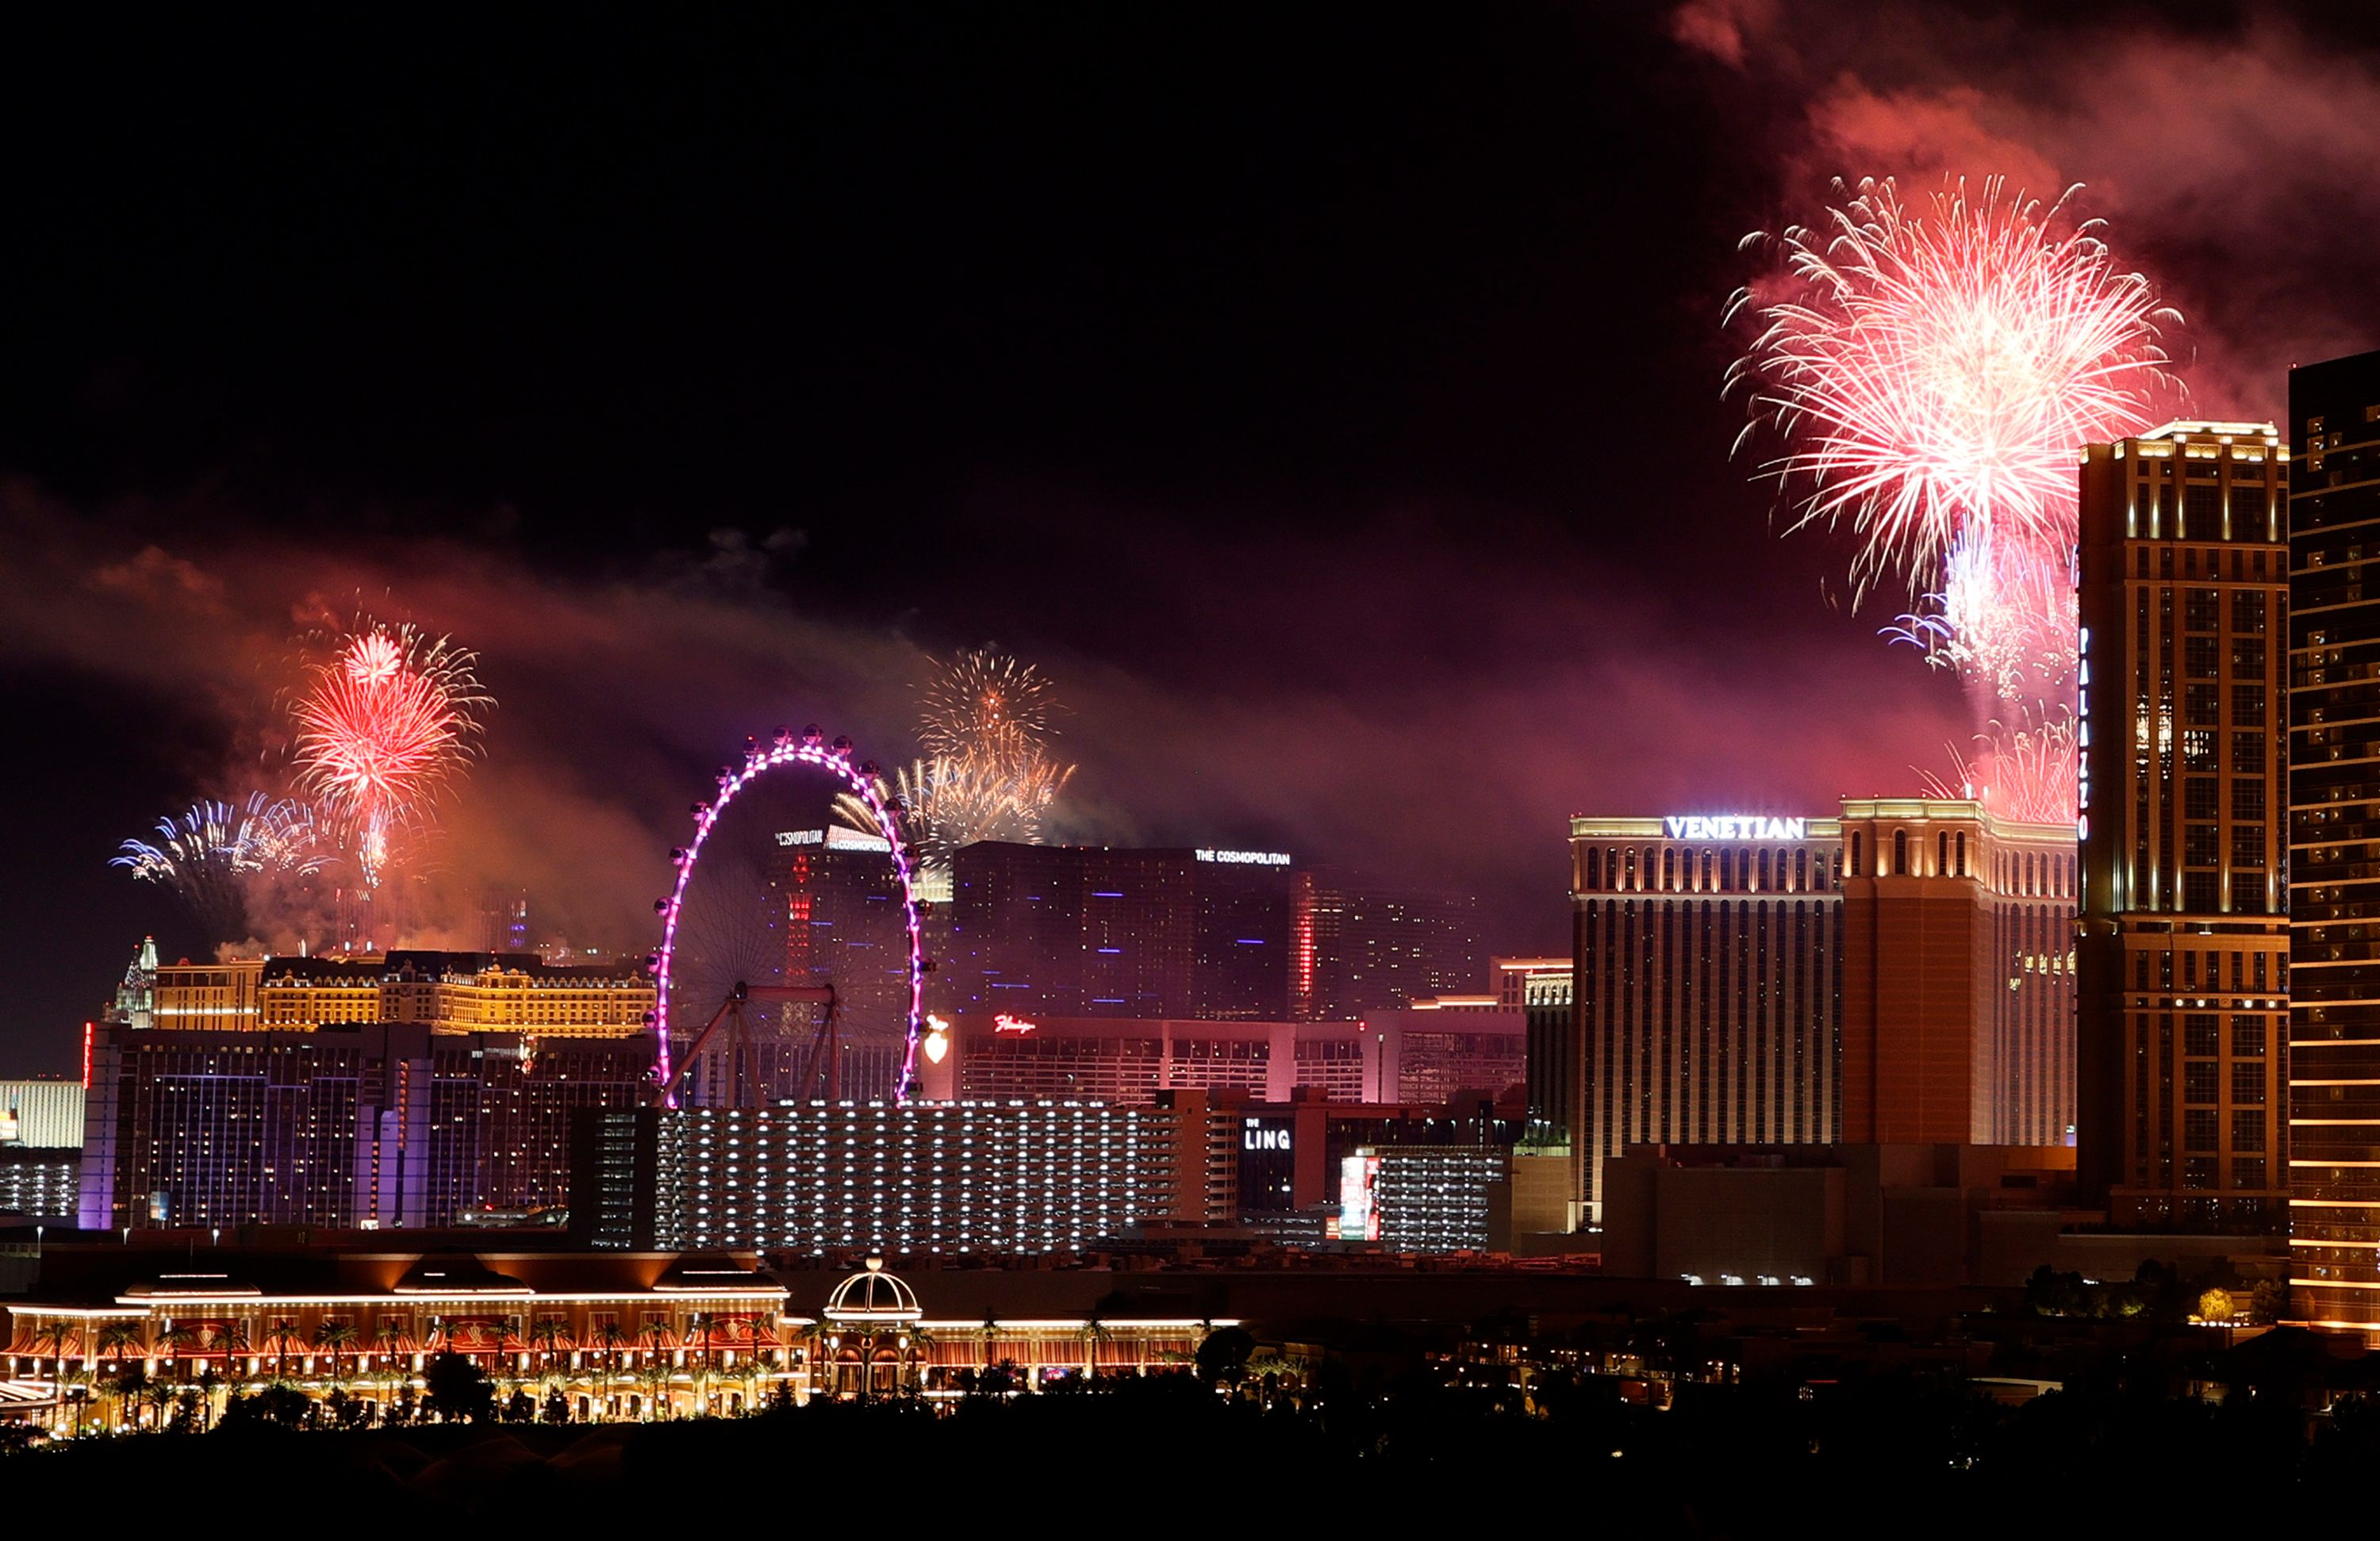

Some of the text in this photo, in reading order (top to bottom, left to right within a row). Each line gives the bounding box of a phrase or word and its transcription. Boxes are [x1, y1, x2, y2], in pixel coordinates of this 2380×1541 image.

[2078, 627, 2090, 841] PALAZZO
[1665, 815, 1806, 839] VENETIAN
[1195, 849, 1291, 865] THE COSMOPOLITAN
[1246, 1118, 1260, 1128] THE
[1245, 1129, 1290, 1150] LINQ
